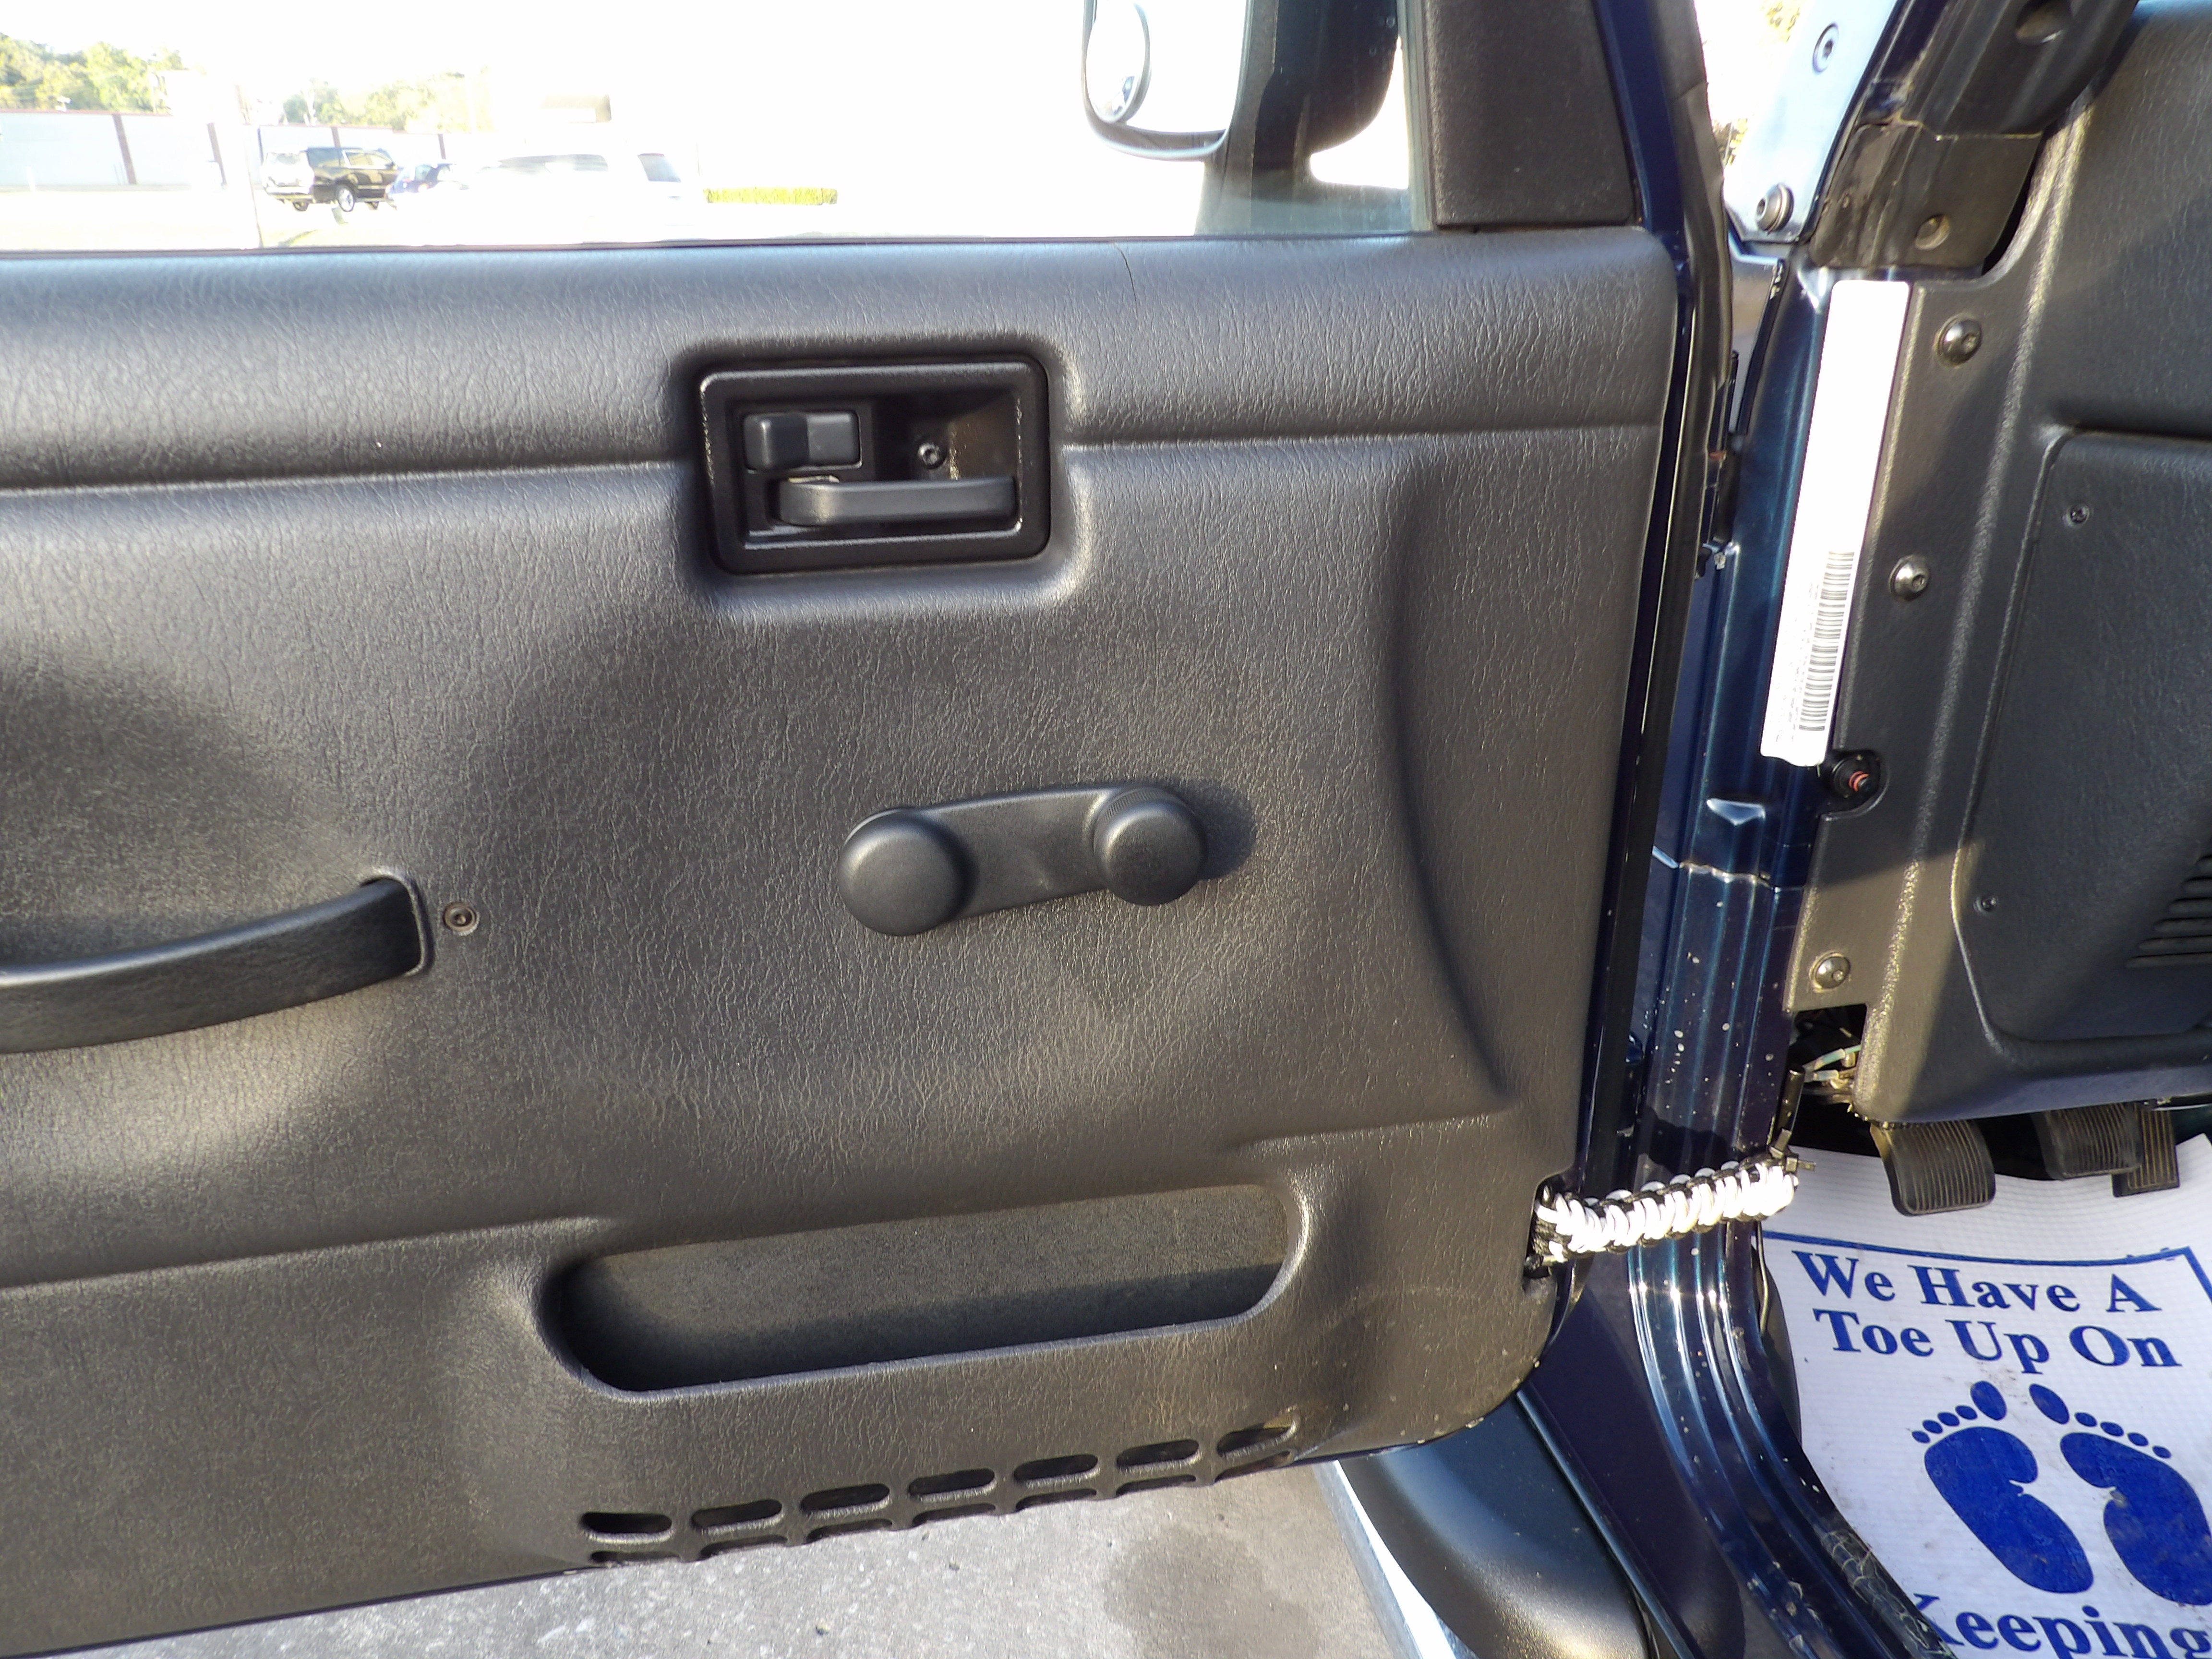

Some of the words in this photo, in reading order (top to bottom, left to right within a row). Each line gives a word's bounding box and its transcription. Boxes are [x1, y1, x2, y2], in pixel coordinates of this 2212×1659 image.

[1791, 1250, 1896, 1301] We
[1910, 1264, 2081, 1312] Have
[2106, 1273, 2162, 1312] A
[1813, 1309, 1934, 1357] Toe
[1946, 1320, 2050, 1374] Up
[2069, 1325, 2183, 1367] On
